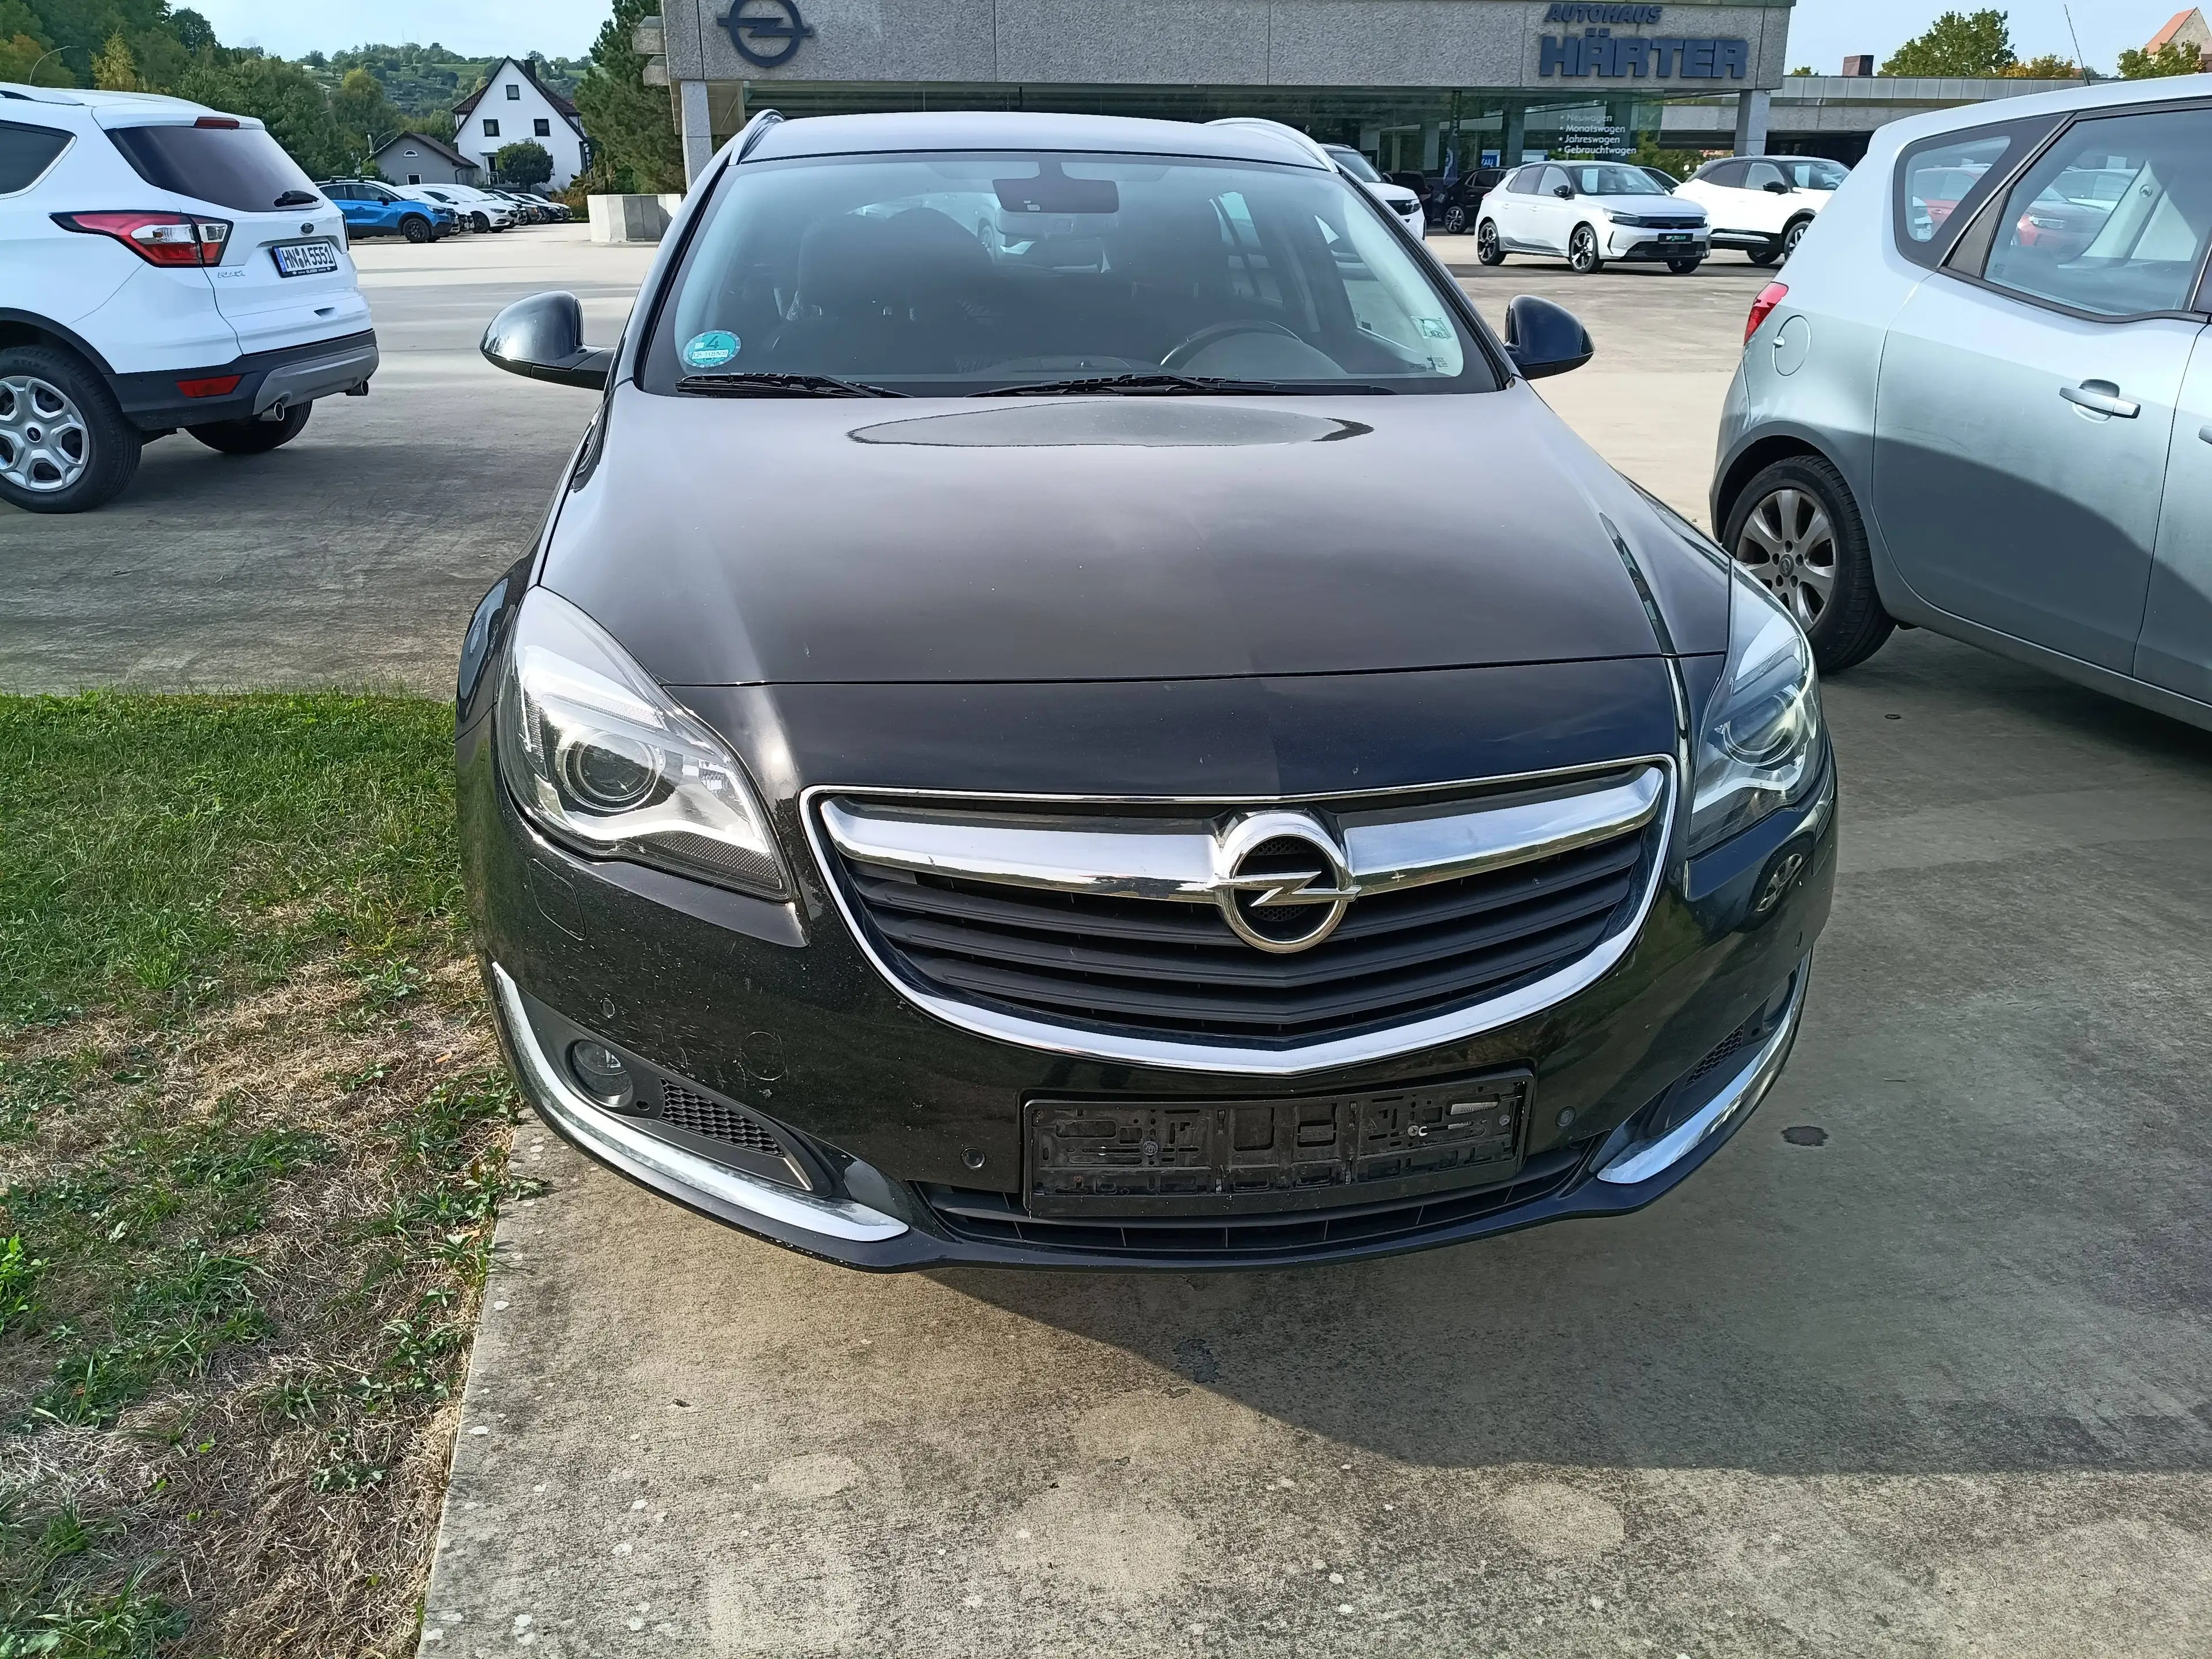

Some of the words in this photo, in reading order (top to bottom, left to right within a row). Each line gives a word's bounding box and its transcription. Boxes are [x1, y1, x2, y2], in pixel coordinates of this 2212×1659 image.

[1544, 3, 1663, 24] AUTOHAUS
[1540, 28, 1749, 79] HÄRTER
[1567, 113, 1612, 123] Neuwagen
[1566, 124, 1626, 134] Monatswagen
[1565, 134, 1620, 145] Jahreswagen
[1564, 145, 1637, 156] Gebrauchtwagen
[281, 249, 300, 268] HN
[706, 335, 719, 349] 4
